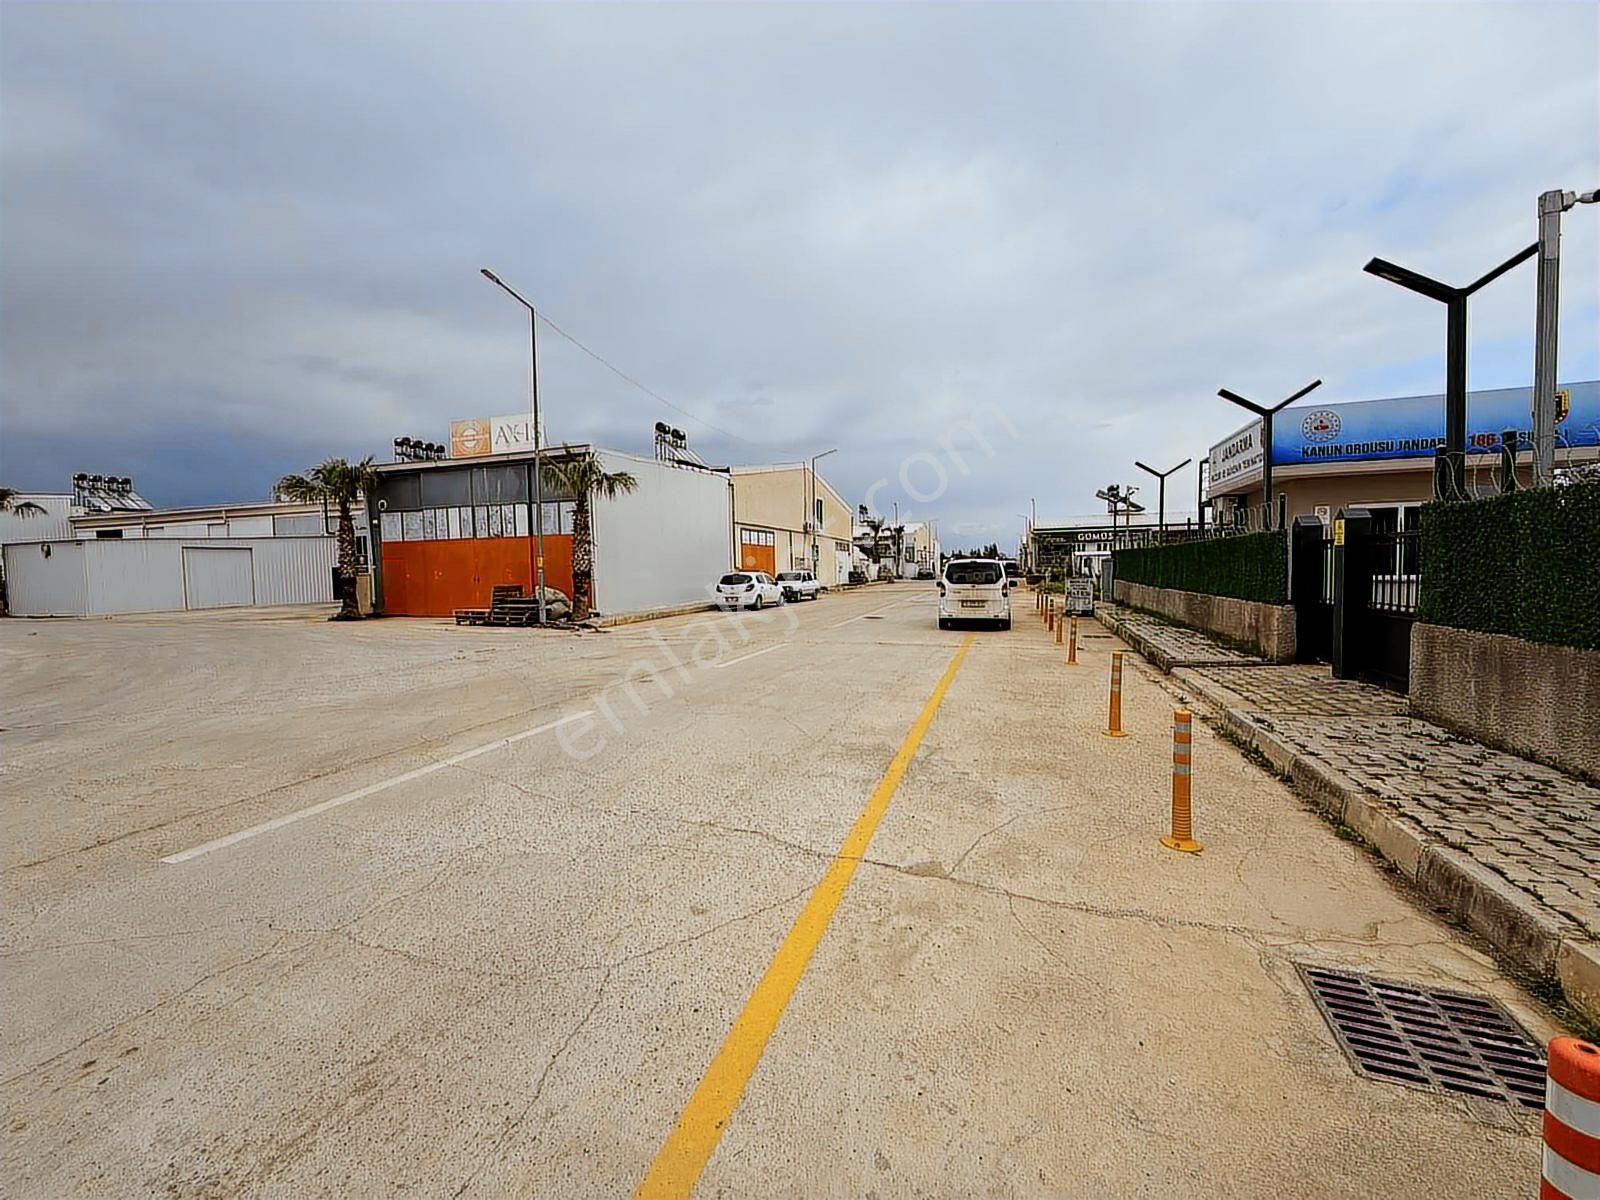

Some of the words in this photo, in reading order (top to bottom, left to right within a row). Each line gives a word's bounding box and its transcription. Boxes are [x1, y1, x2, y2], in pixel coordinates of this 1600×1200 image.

[1302, 443, 1343, 458] KANUN
[1345, 440, 1394, 455] ORDUSU
[1397, 436, 1446, 451] JANDAR
